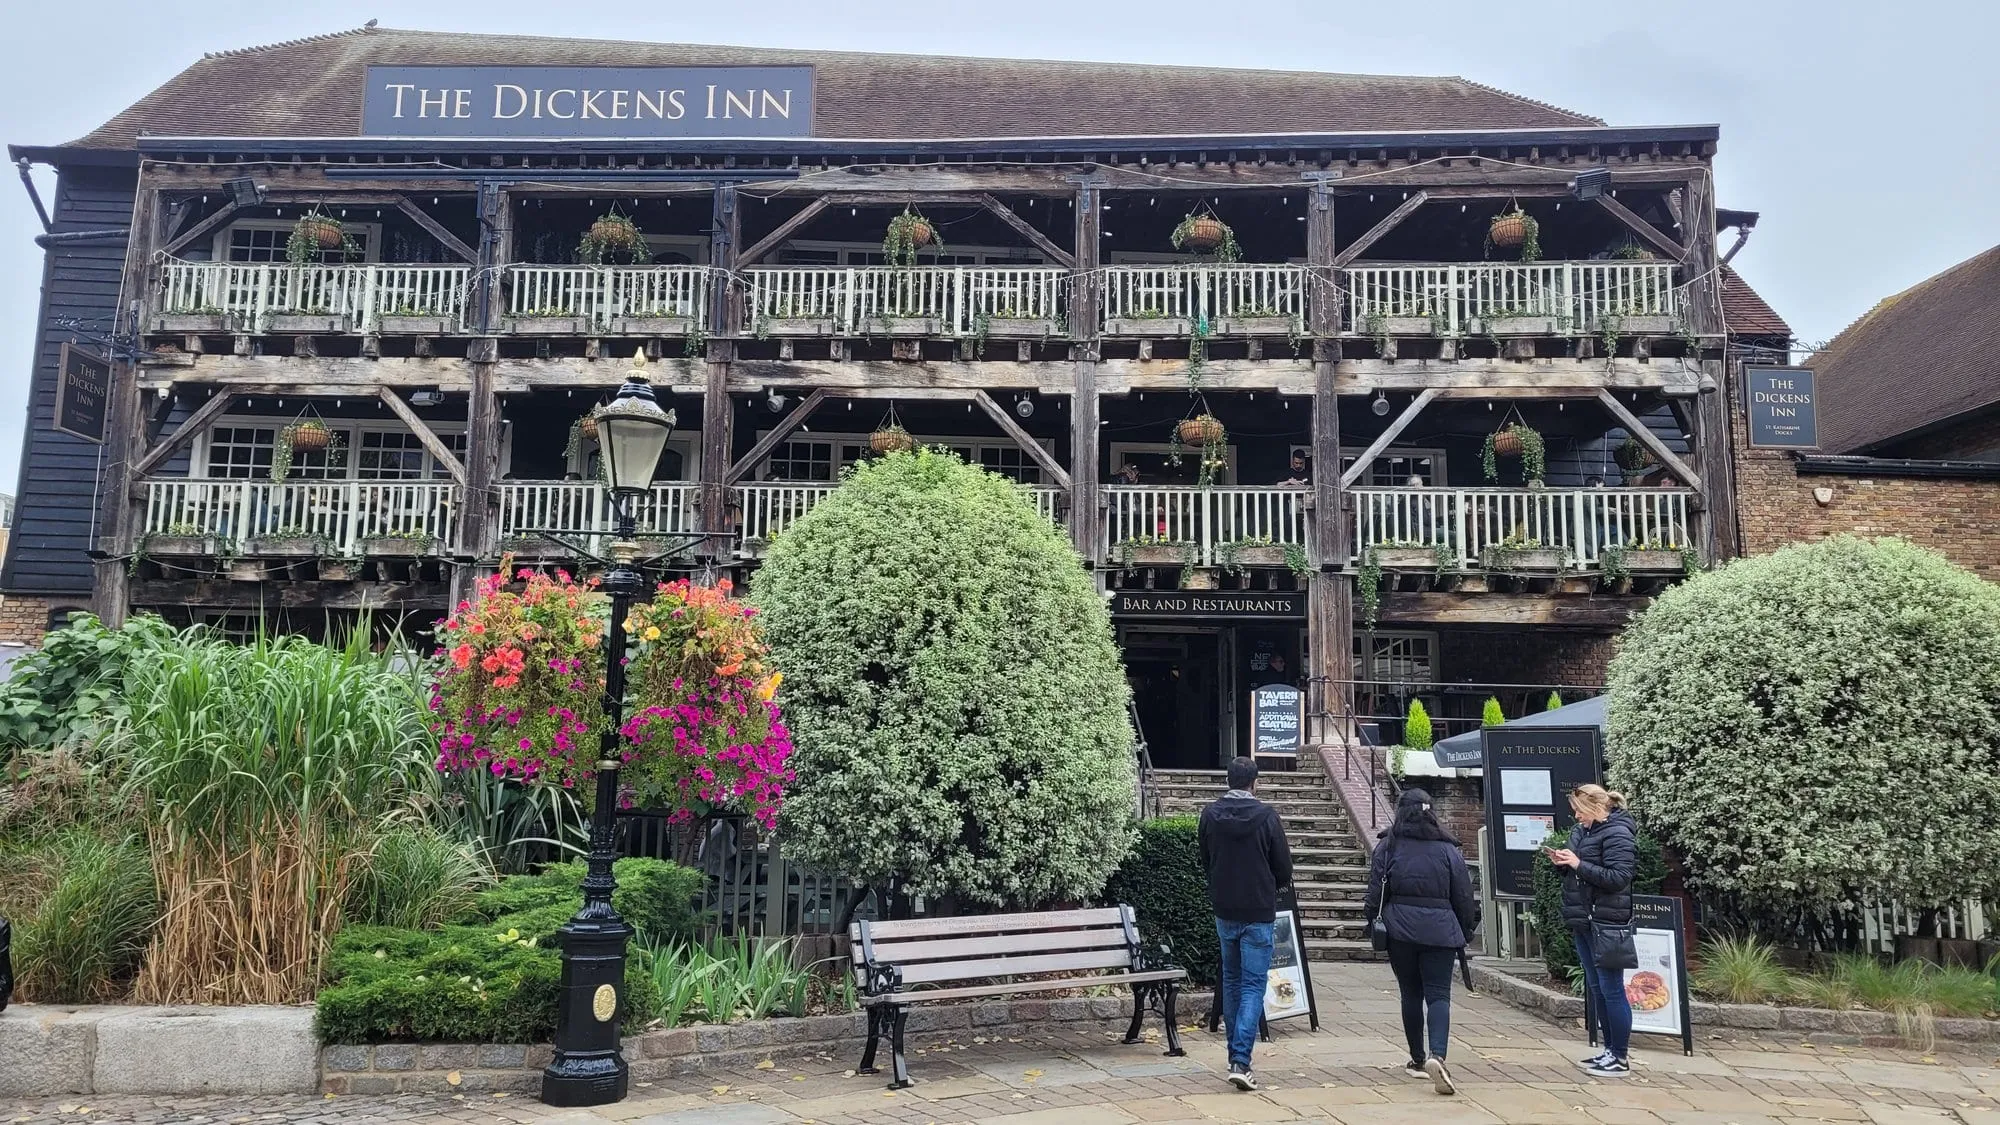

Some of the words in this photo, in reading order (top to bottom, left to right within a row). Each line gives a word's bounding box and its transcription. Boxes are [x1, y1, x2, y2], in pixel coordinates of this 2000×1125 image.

[385, 84, 472, 119] THE
[492, 84, 686, 120] DICKENS
[704, 84, 793, 120] INN
[80, 363, 97, 379] THE
[68, 373, 105, 397] DICKENS
[1769, 378, 1794, 389] THE
[76, 391, 93, 407] INN
[1755, 391, 1810, 404] DICKENS
[1771, 406, 1796, 417] INN
[1123, 597, 1151, 610] BAR
[1155, 599, 1187, 611] AND
[1192, 598, 1292, 612] RESTAURANTS
[1259, 690, 1298, 700] TAVERN
[1259, 699, 1279, 708] BAR
[1501, 745, 1513, 755] AT
[1515, 745, 1534, 755] THE
[1538, 745, 1581, 755] DICKENS
[1447, 752, 1456, 763] THE
[1456, 751, 1473, 761] DICKENS
[1654, 904, 1671, 912] INN
